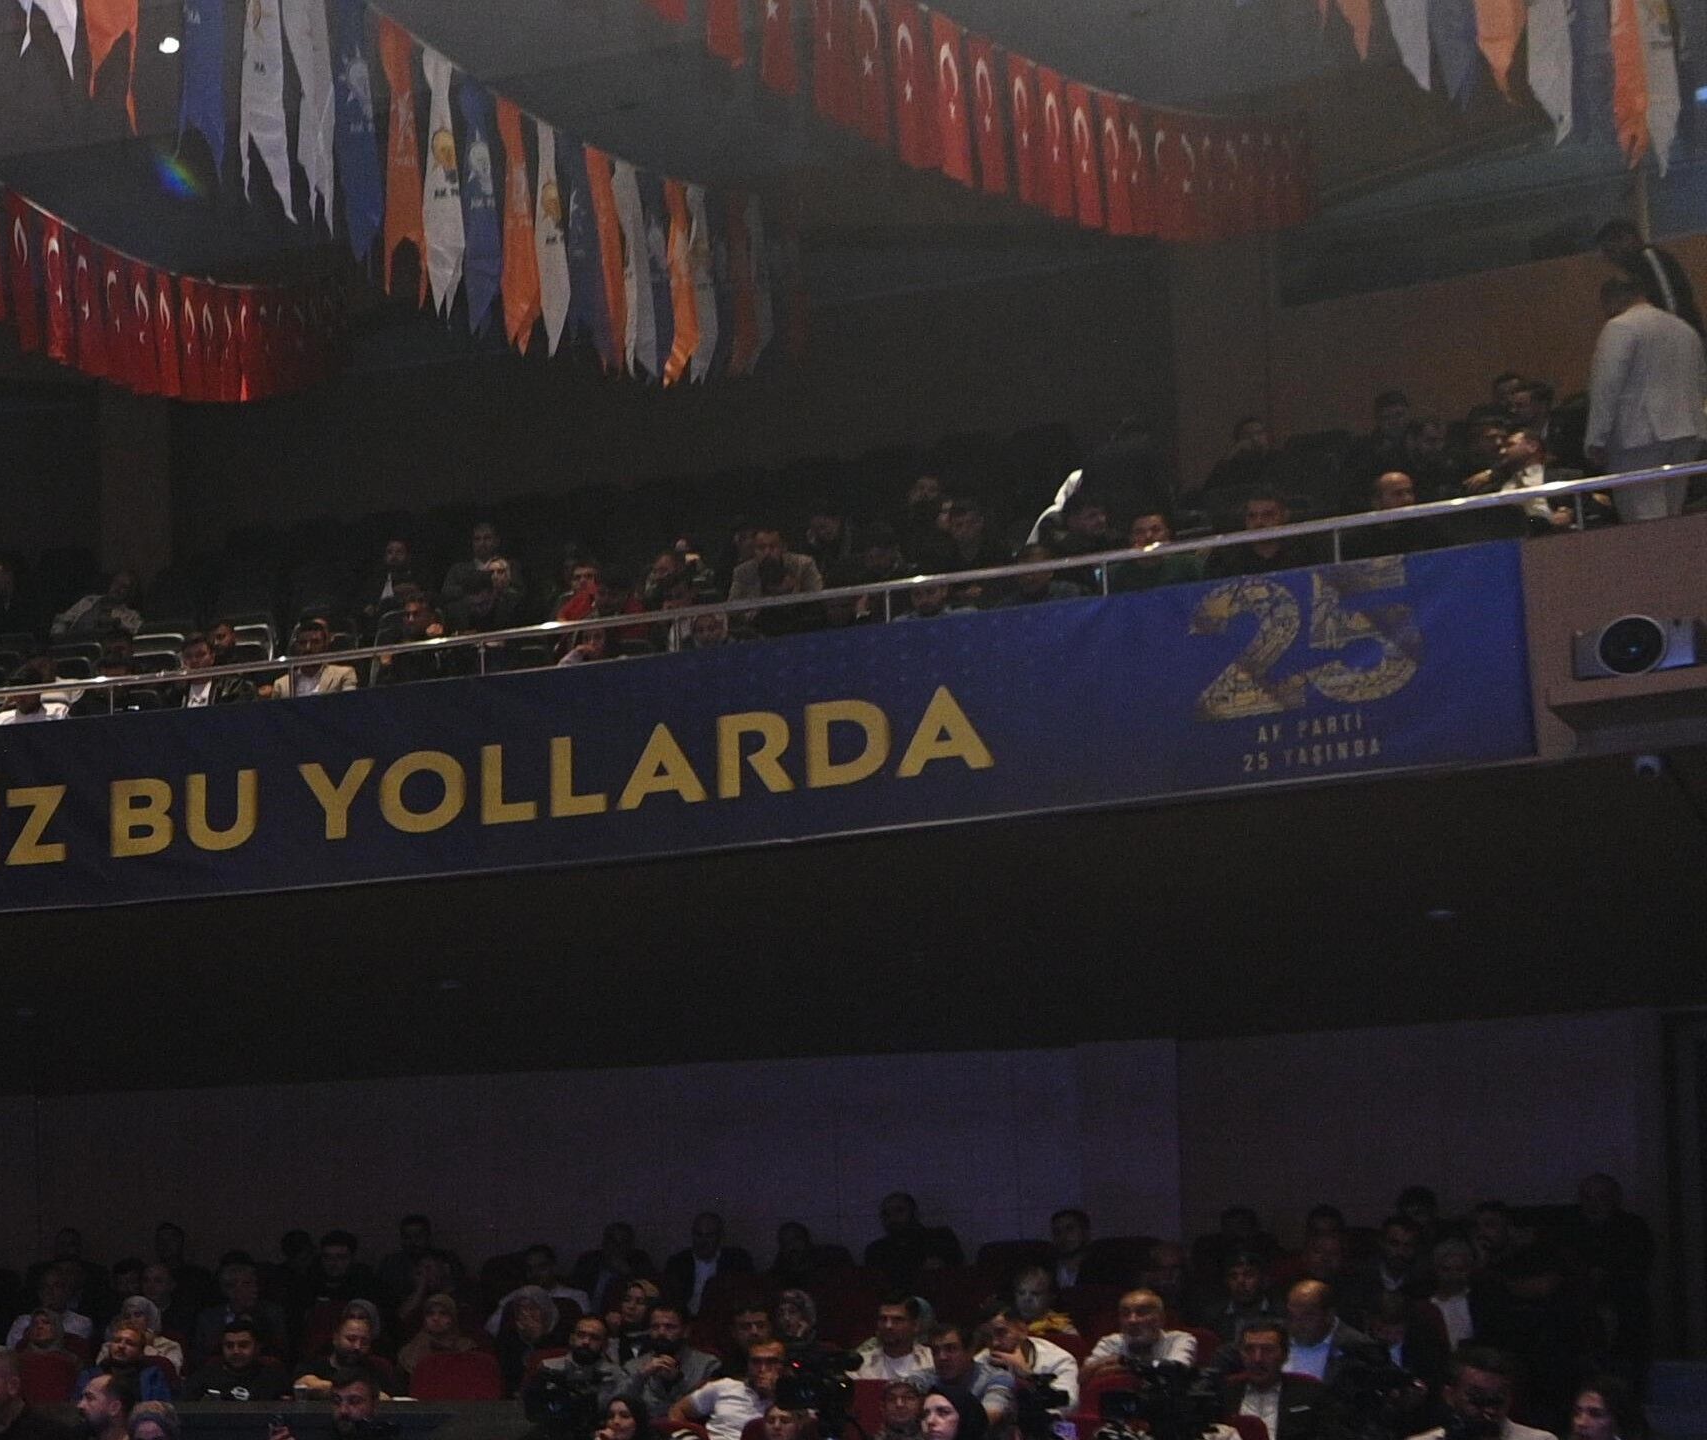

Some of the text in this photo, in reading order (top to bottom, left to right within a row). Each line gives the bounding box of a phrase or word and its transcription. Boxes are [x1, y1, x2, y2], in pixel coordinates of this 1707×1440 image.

[1189, 554, 1423, 724] 25
[109, 770, 256, 858] BU
[298, 685, 994, 840] YOLLARDA
[1243, 753, 1269, 772] 25
